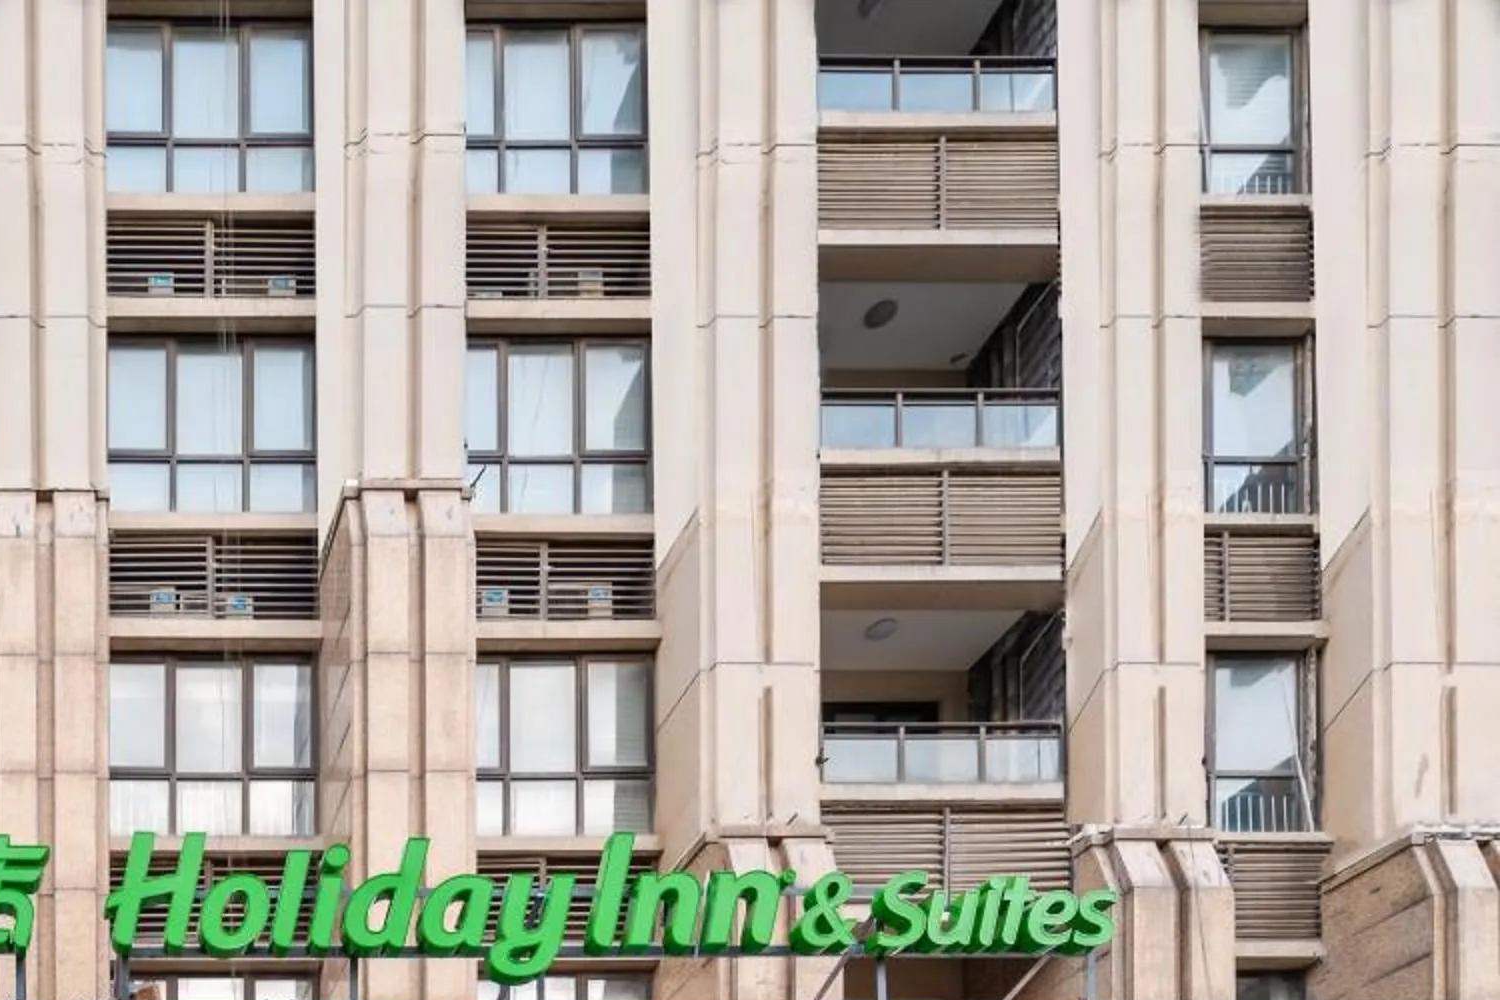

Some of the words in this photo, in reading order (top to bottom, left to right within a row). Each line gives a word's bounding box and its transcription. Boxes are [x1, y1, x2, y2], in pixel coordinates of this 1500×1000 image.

[105, 831, 575, 984] Holiday
[590, 832, 785, 953] Inn
[793, 870, 854, 952] &
[872, 870, 1118, 955] Suites
